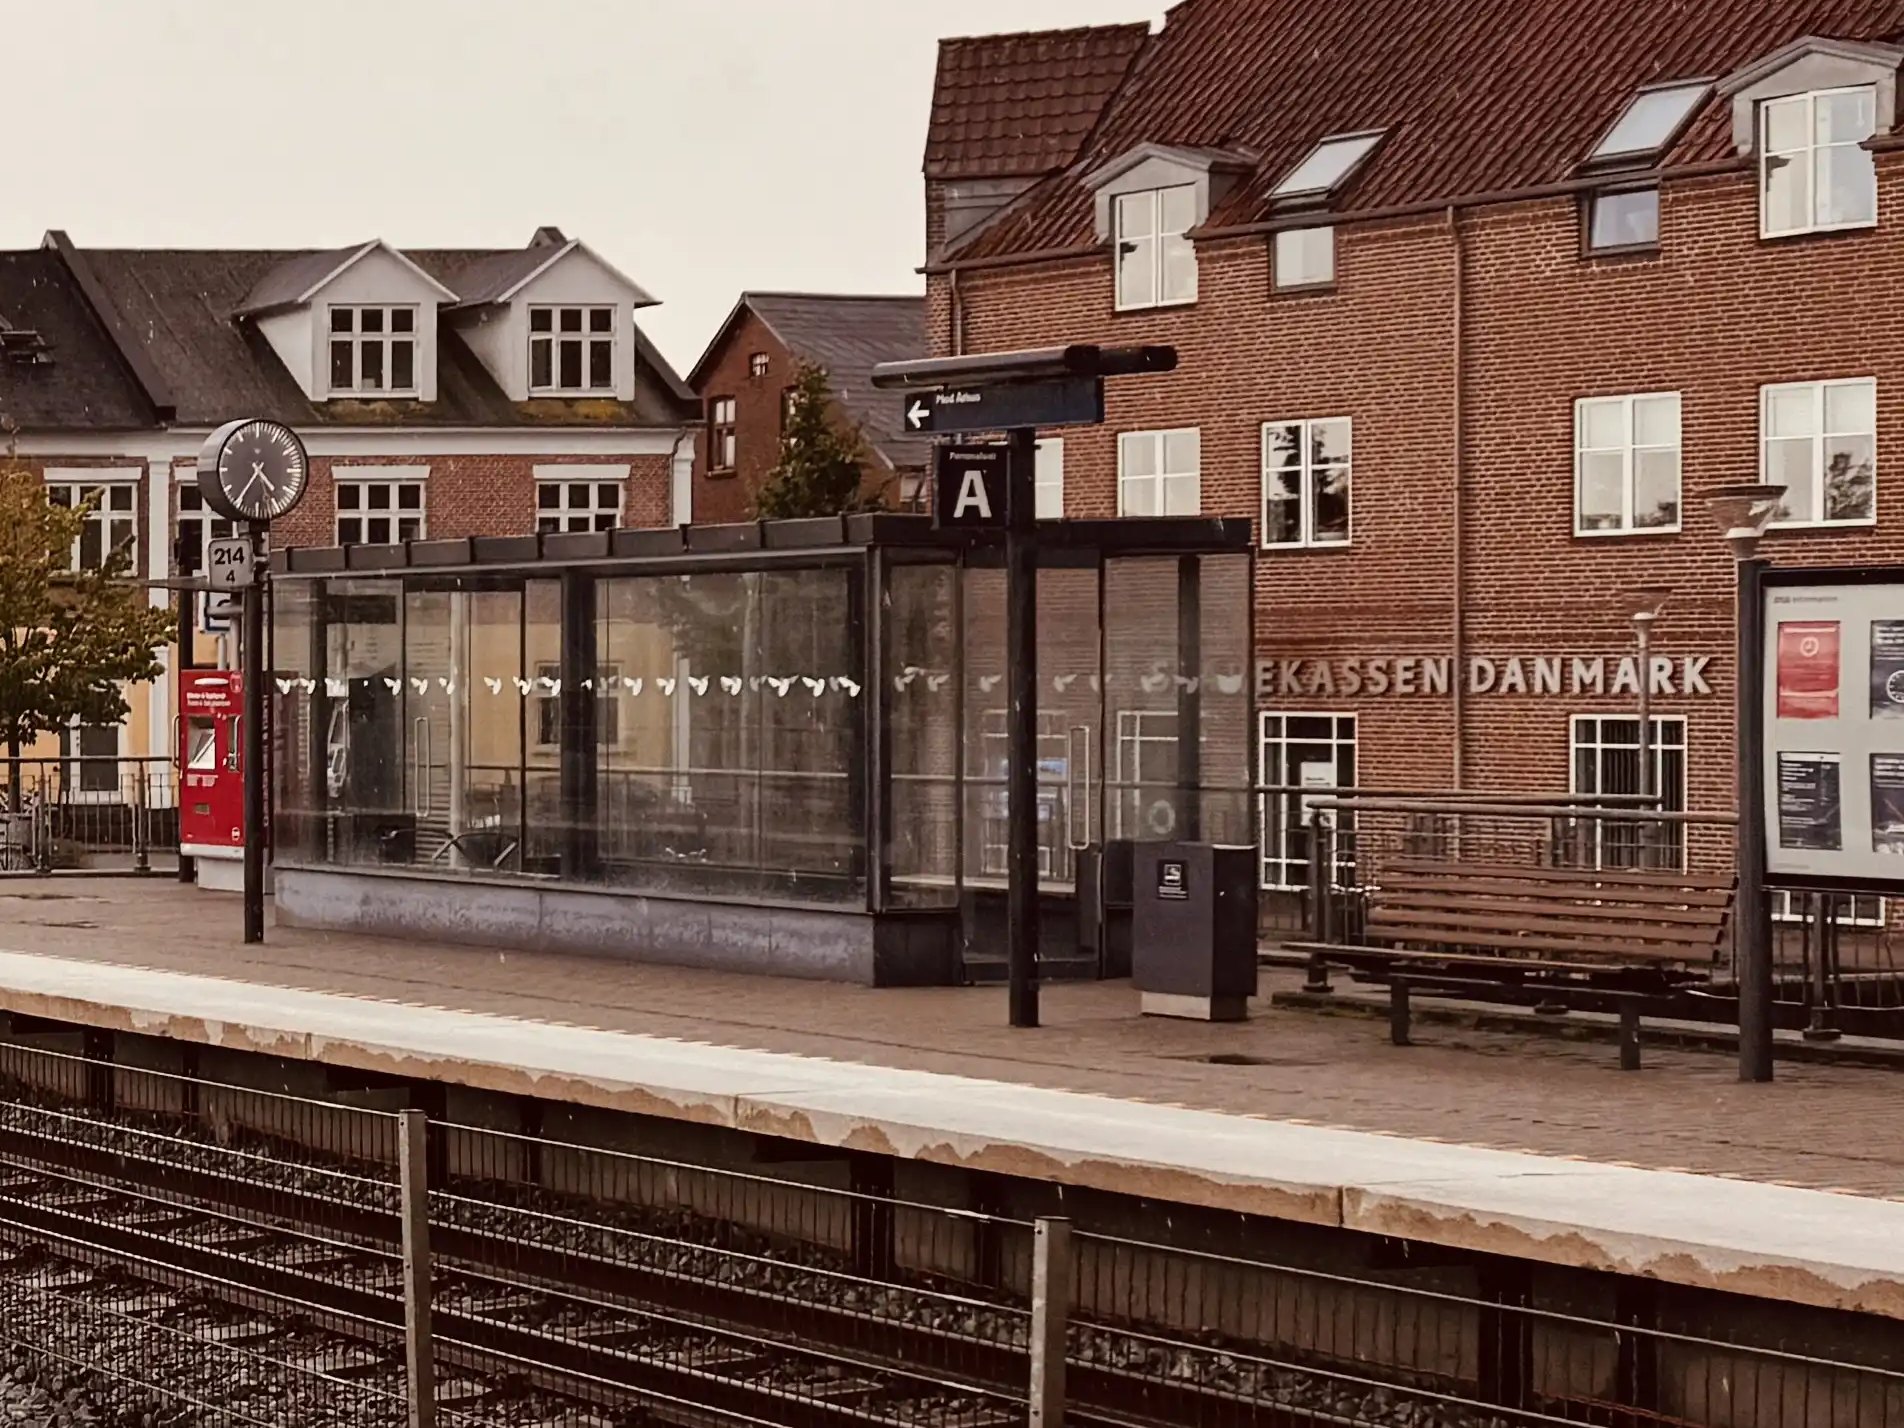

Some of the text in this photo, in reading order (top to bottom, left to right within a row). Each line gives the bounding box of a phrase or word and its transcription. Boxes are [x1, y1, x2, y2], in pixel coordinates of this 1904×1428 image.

[953, 470, 992, 518] A
[214, 547, 245, 566] 214
[225, 569, 236, 584] 4
[1469, 655, 1713, 695] DANMARK
